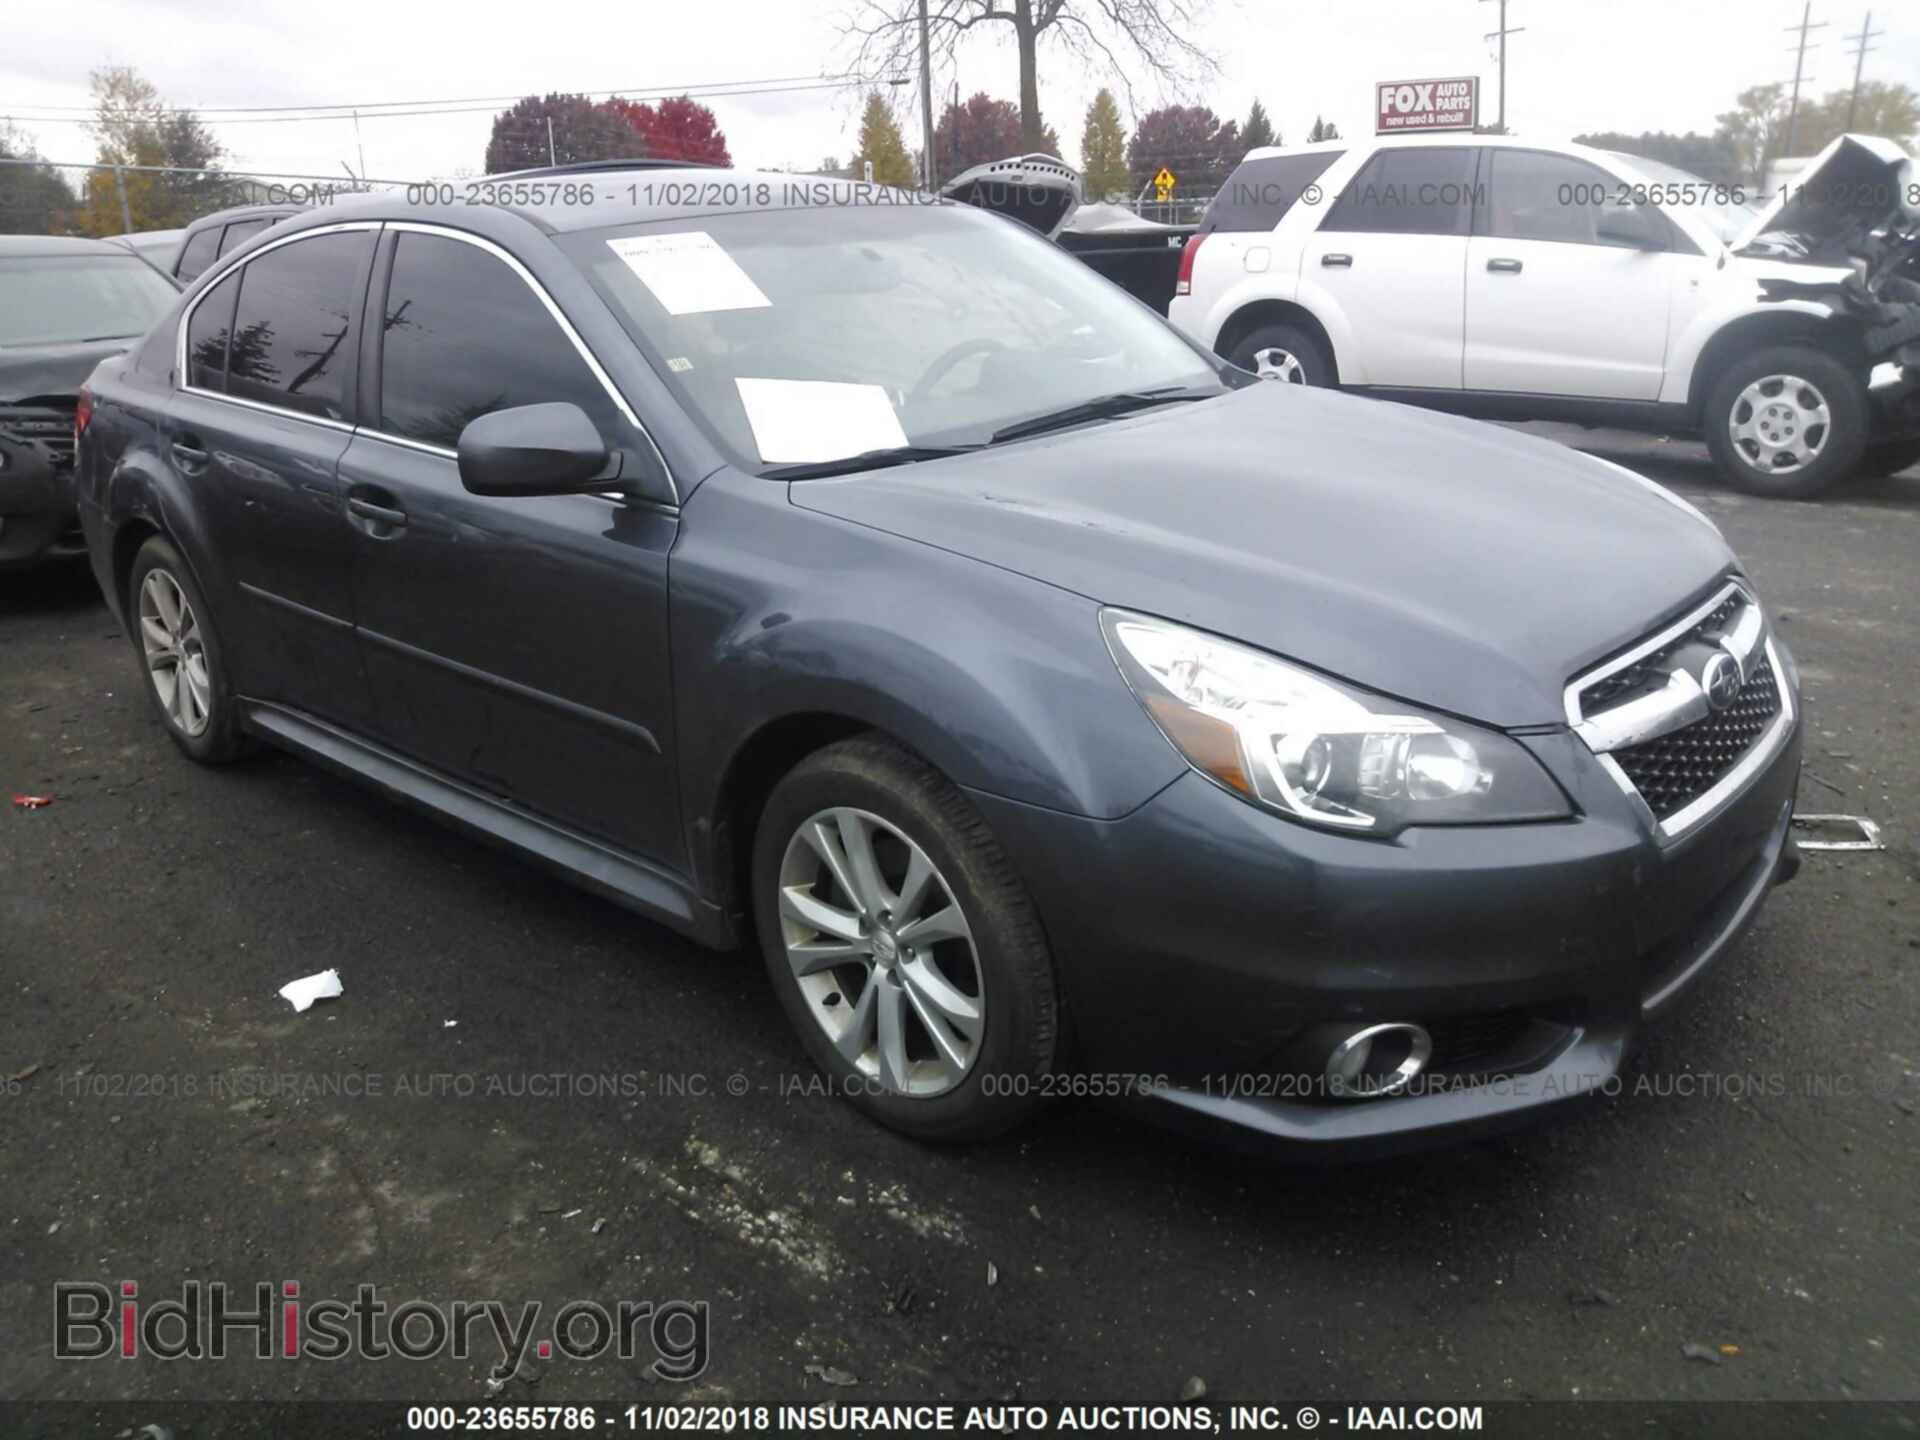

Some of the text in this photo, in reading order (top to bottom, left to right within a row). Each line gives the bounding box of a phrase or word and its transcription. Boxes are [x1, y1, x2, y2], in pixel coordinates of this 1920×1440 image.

[1436, 83, 1468, 97] AUTO
[1381, 84, 1434, 114] FOX
[1436, 97, 1470, 111] PARTS
[1386, 116, 1404, 126] new
[1405, 113, 1427, 125] used
